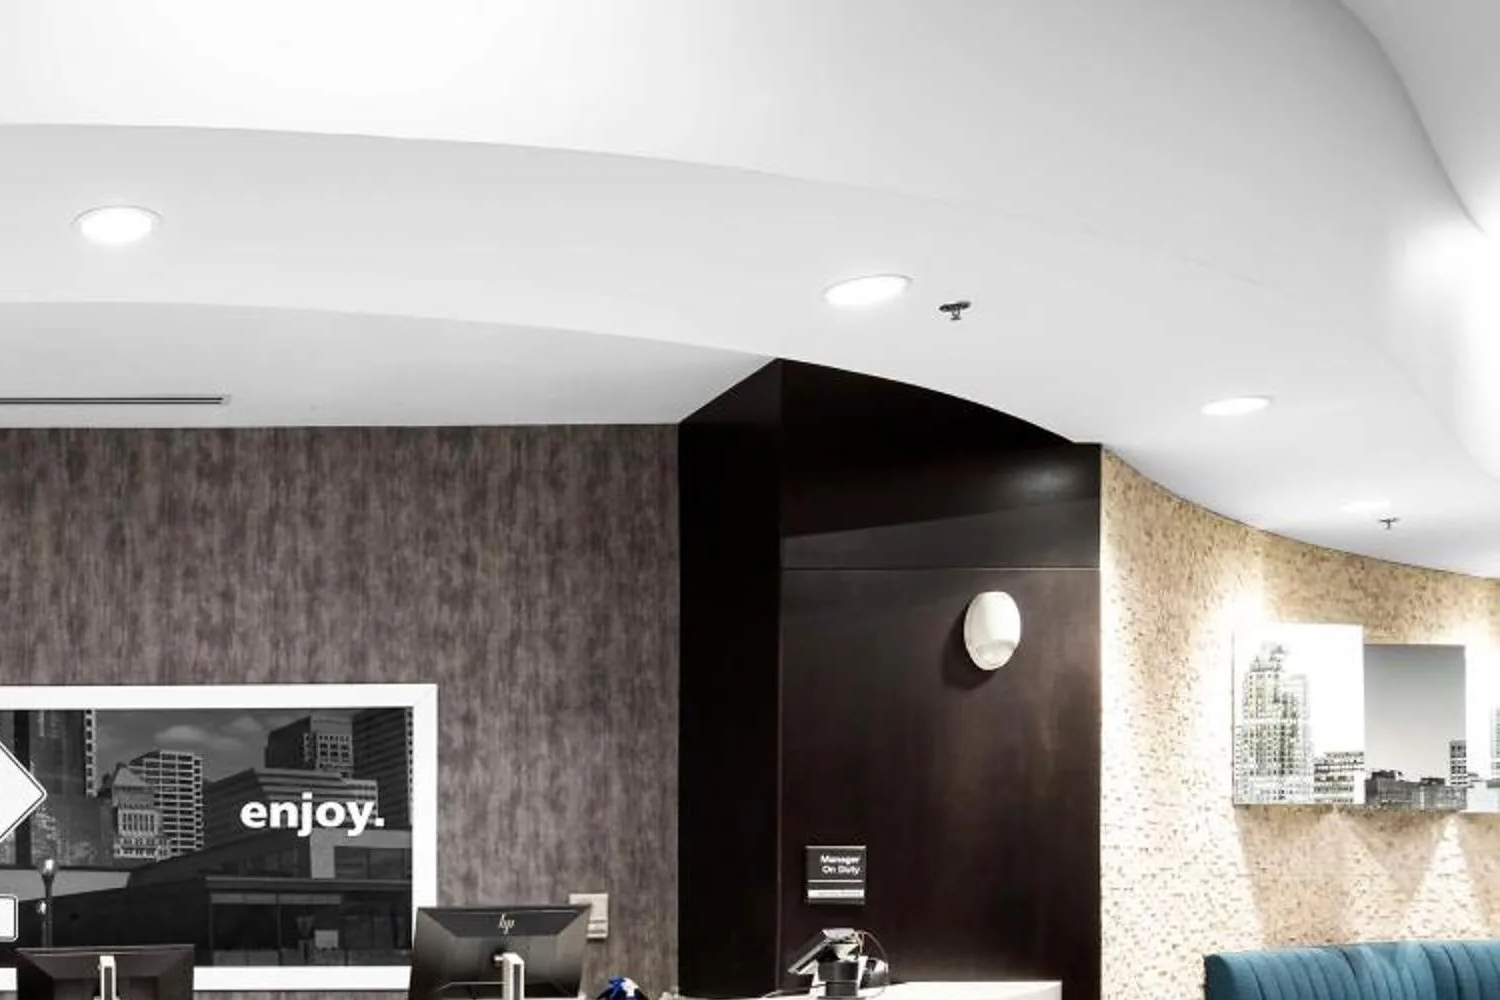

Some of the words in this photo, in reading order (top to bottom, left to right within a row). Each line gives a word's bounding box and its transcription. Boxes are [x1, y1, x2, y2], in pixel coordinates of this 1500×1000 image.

[240, 792, 385, 837] enjoy.
[820, 855, 860, 865] Manager
[822, 865, 836, 874] On
[838, 865, 860, 876] Duty
[498, 912, 515, 934] hp
